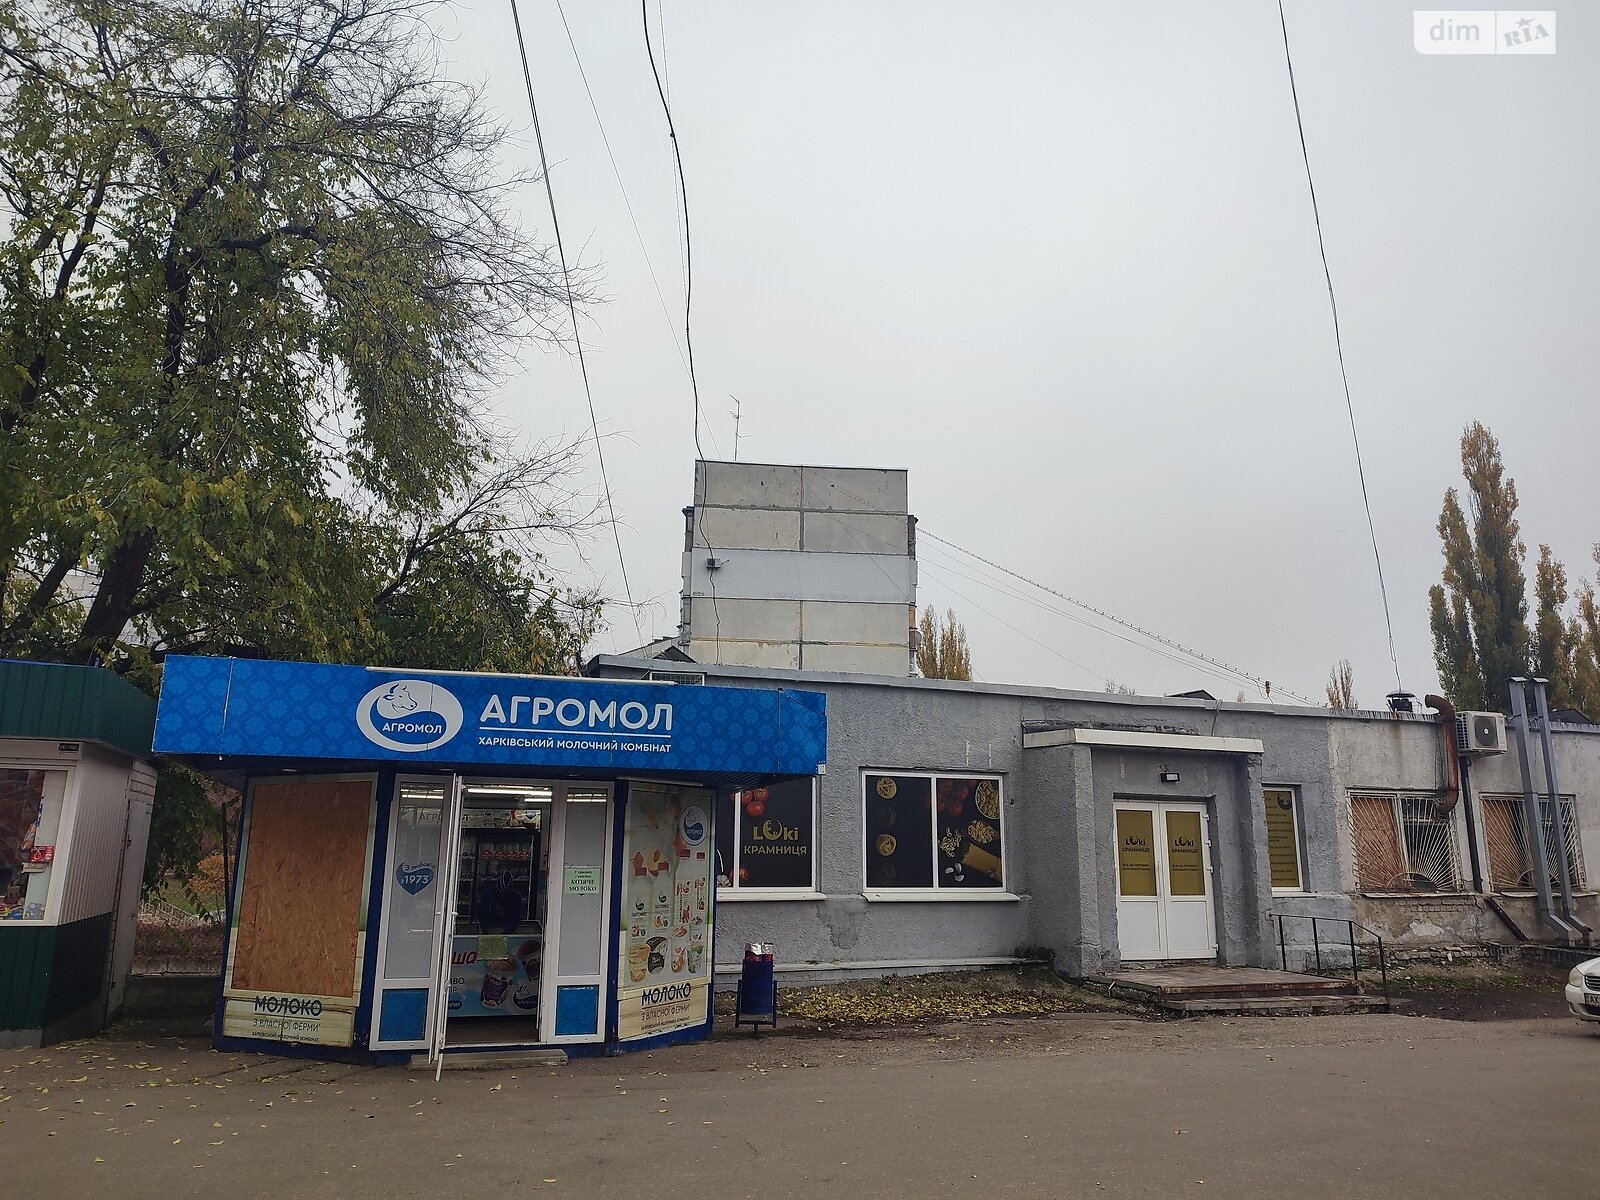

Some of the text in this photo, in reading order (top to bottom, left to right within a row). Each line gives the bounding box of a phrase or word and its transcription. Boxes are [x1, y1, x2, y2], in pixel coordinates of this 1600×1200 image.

[479, 694, 673, 731] АГРОМОЛ
[382, 722, 442, 734] АГРОМОЛ
[478, 736, 672, 753] ХАРКІВСЬКИЙ МОЛОЧНИЙ КОМБІНАТ
[744, 845, 807, 856] КРАМНИЦЯ
[404, 875, 429, 884] 1973
[641, 983, 691, 1006] МОЛОКО
[254, 995, 322, 1016] МОЛОКО
[252, 1018, 258, 1027] З
[259, 1019, 292, 1030] ВЛАСНОЇ
